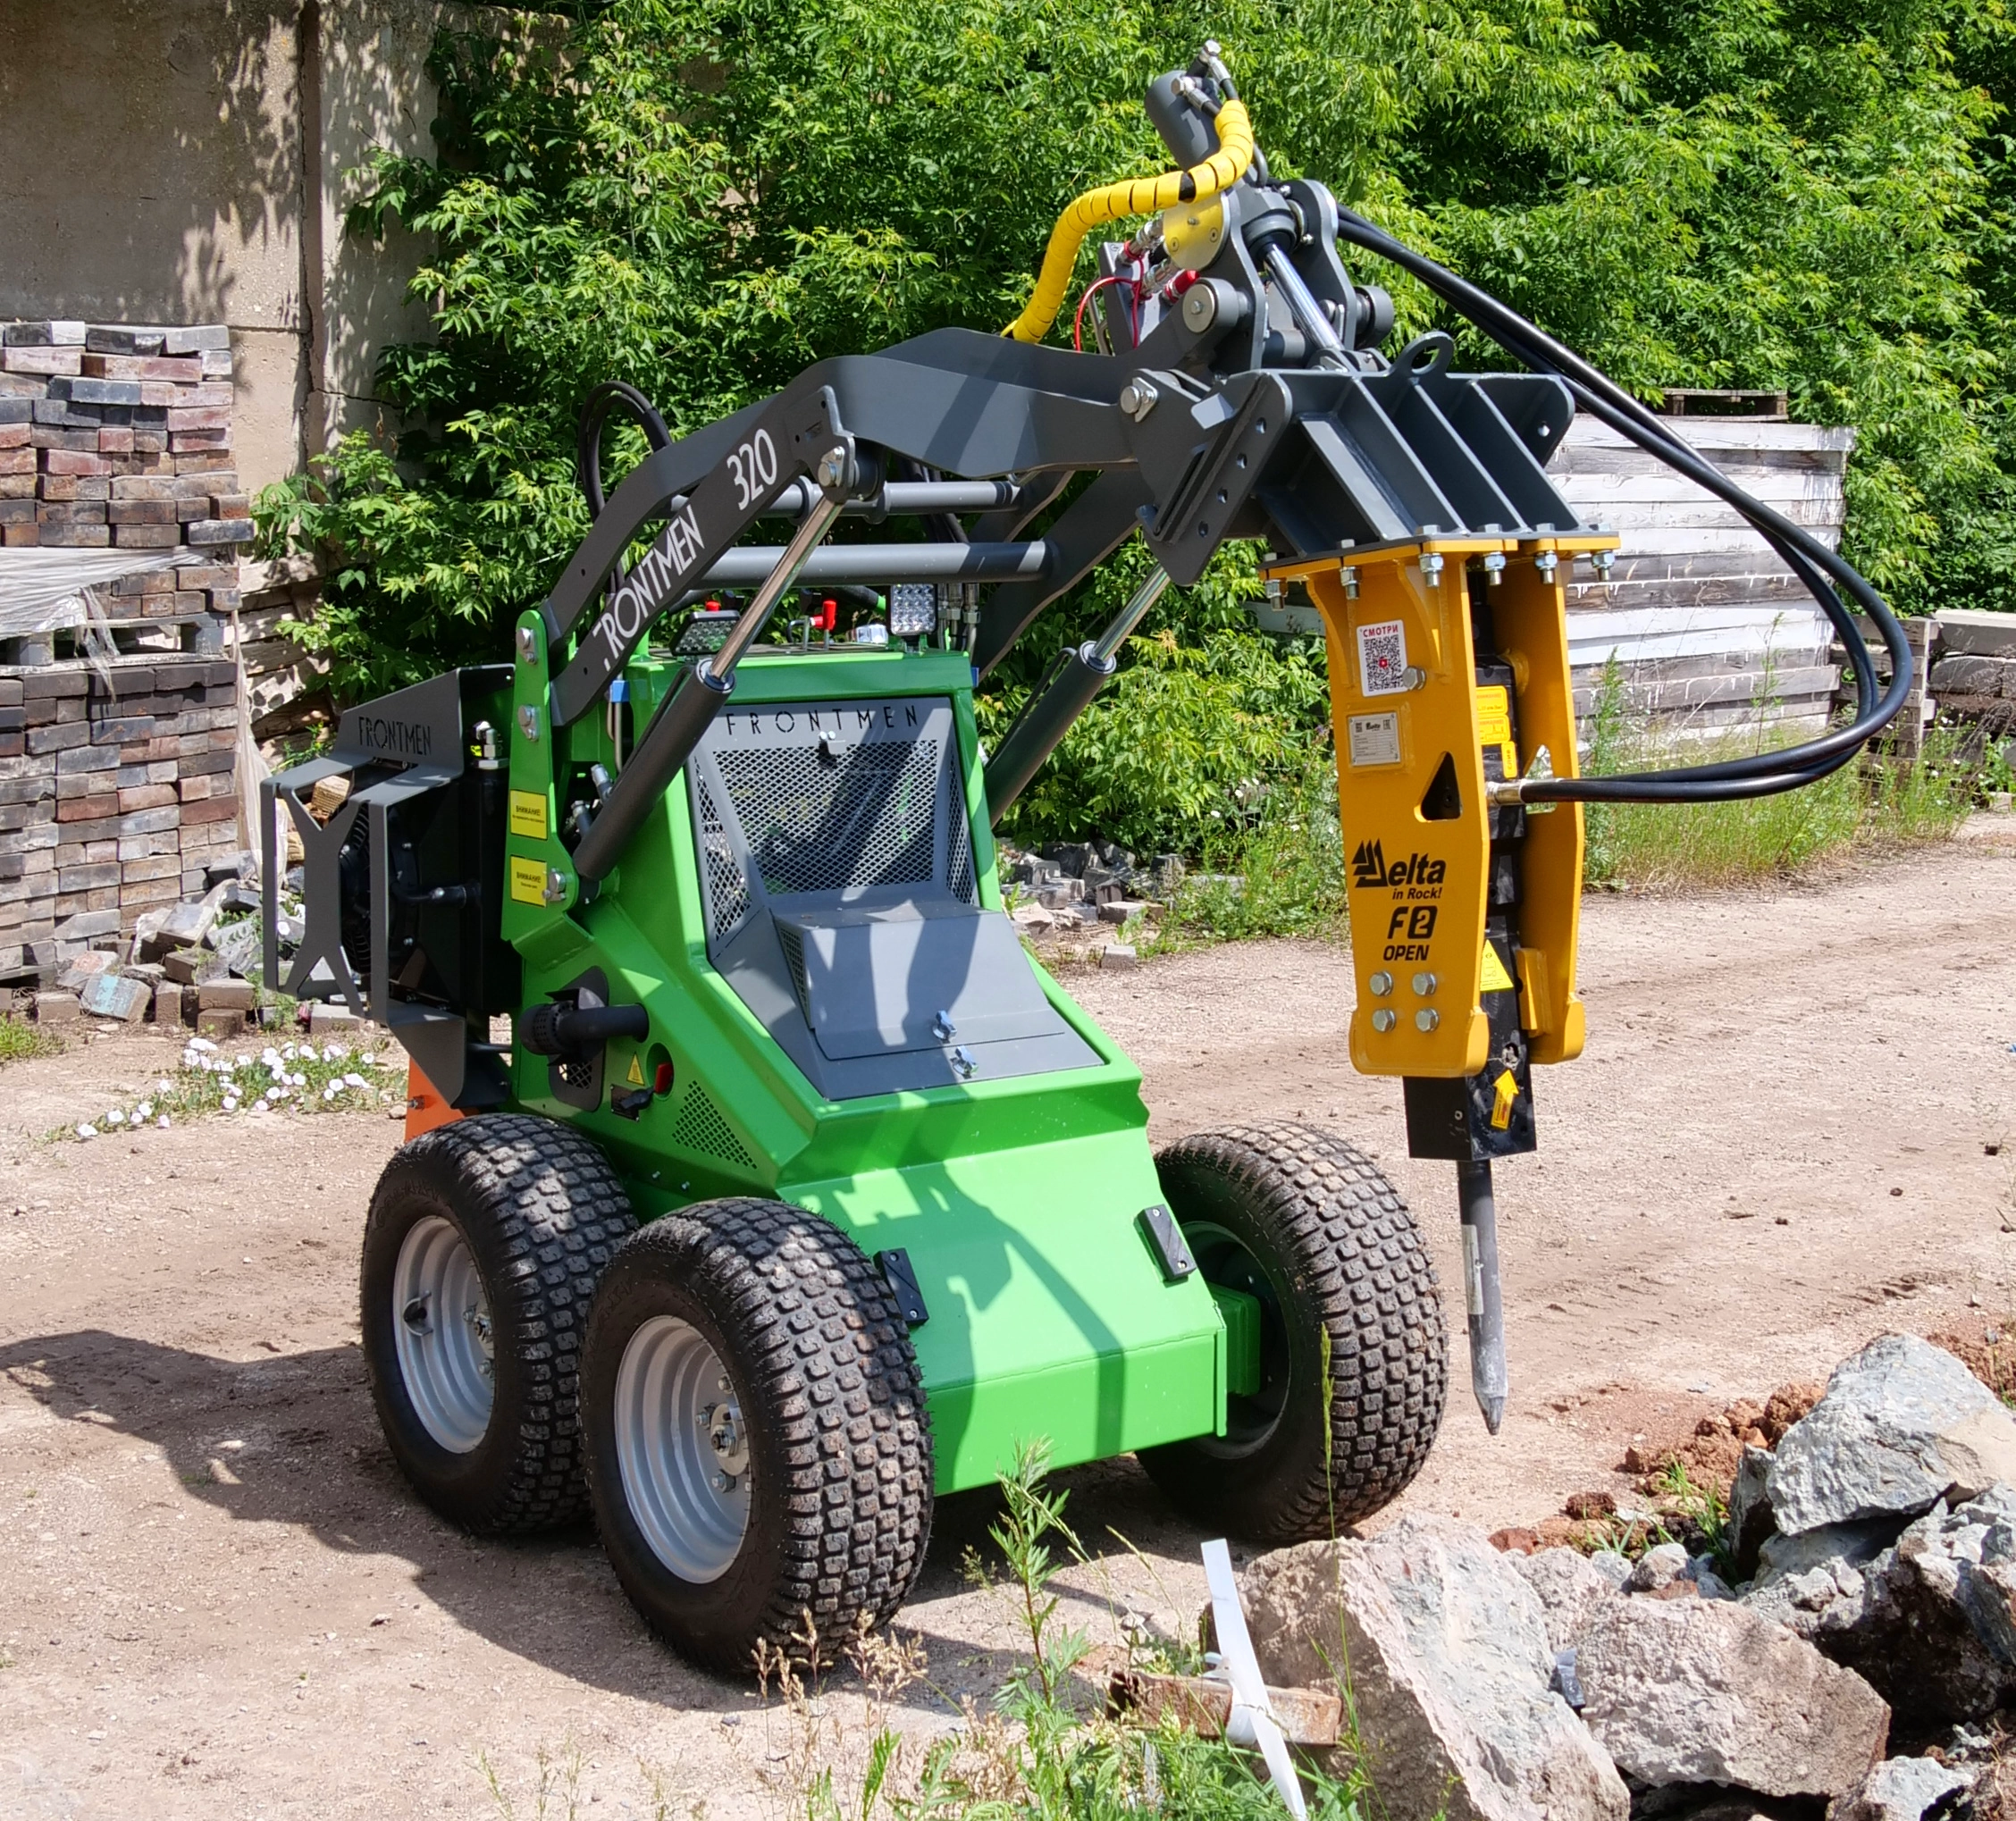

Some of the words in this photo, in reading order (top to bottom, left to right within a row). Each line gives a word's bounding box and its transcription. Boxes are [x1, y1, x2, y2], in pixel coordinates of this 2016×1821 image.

[727, 428, 777, 510] 320
[1363, 625, 1399, 637] СМОТРИ
[726, 705, 918, 735] FRONTMEN
[358, 717, 432, 756] FRONTMEN
[1392, 888, 1404, 901] in
[1407, 887, 1443, 900] Rock!
[1382, 944, 1430, 961] OPEN
